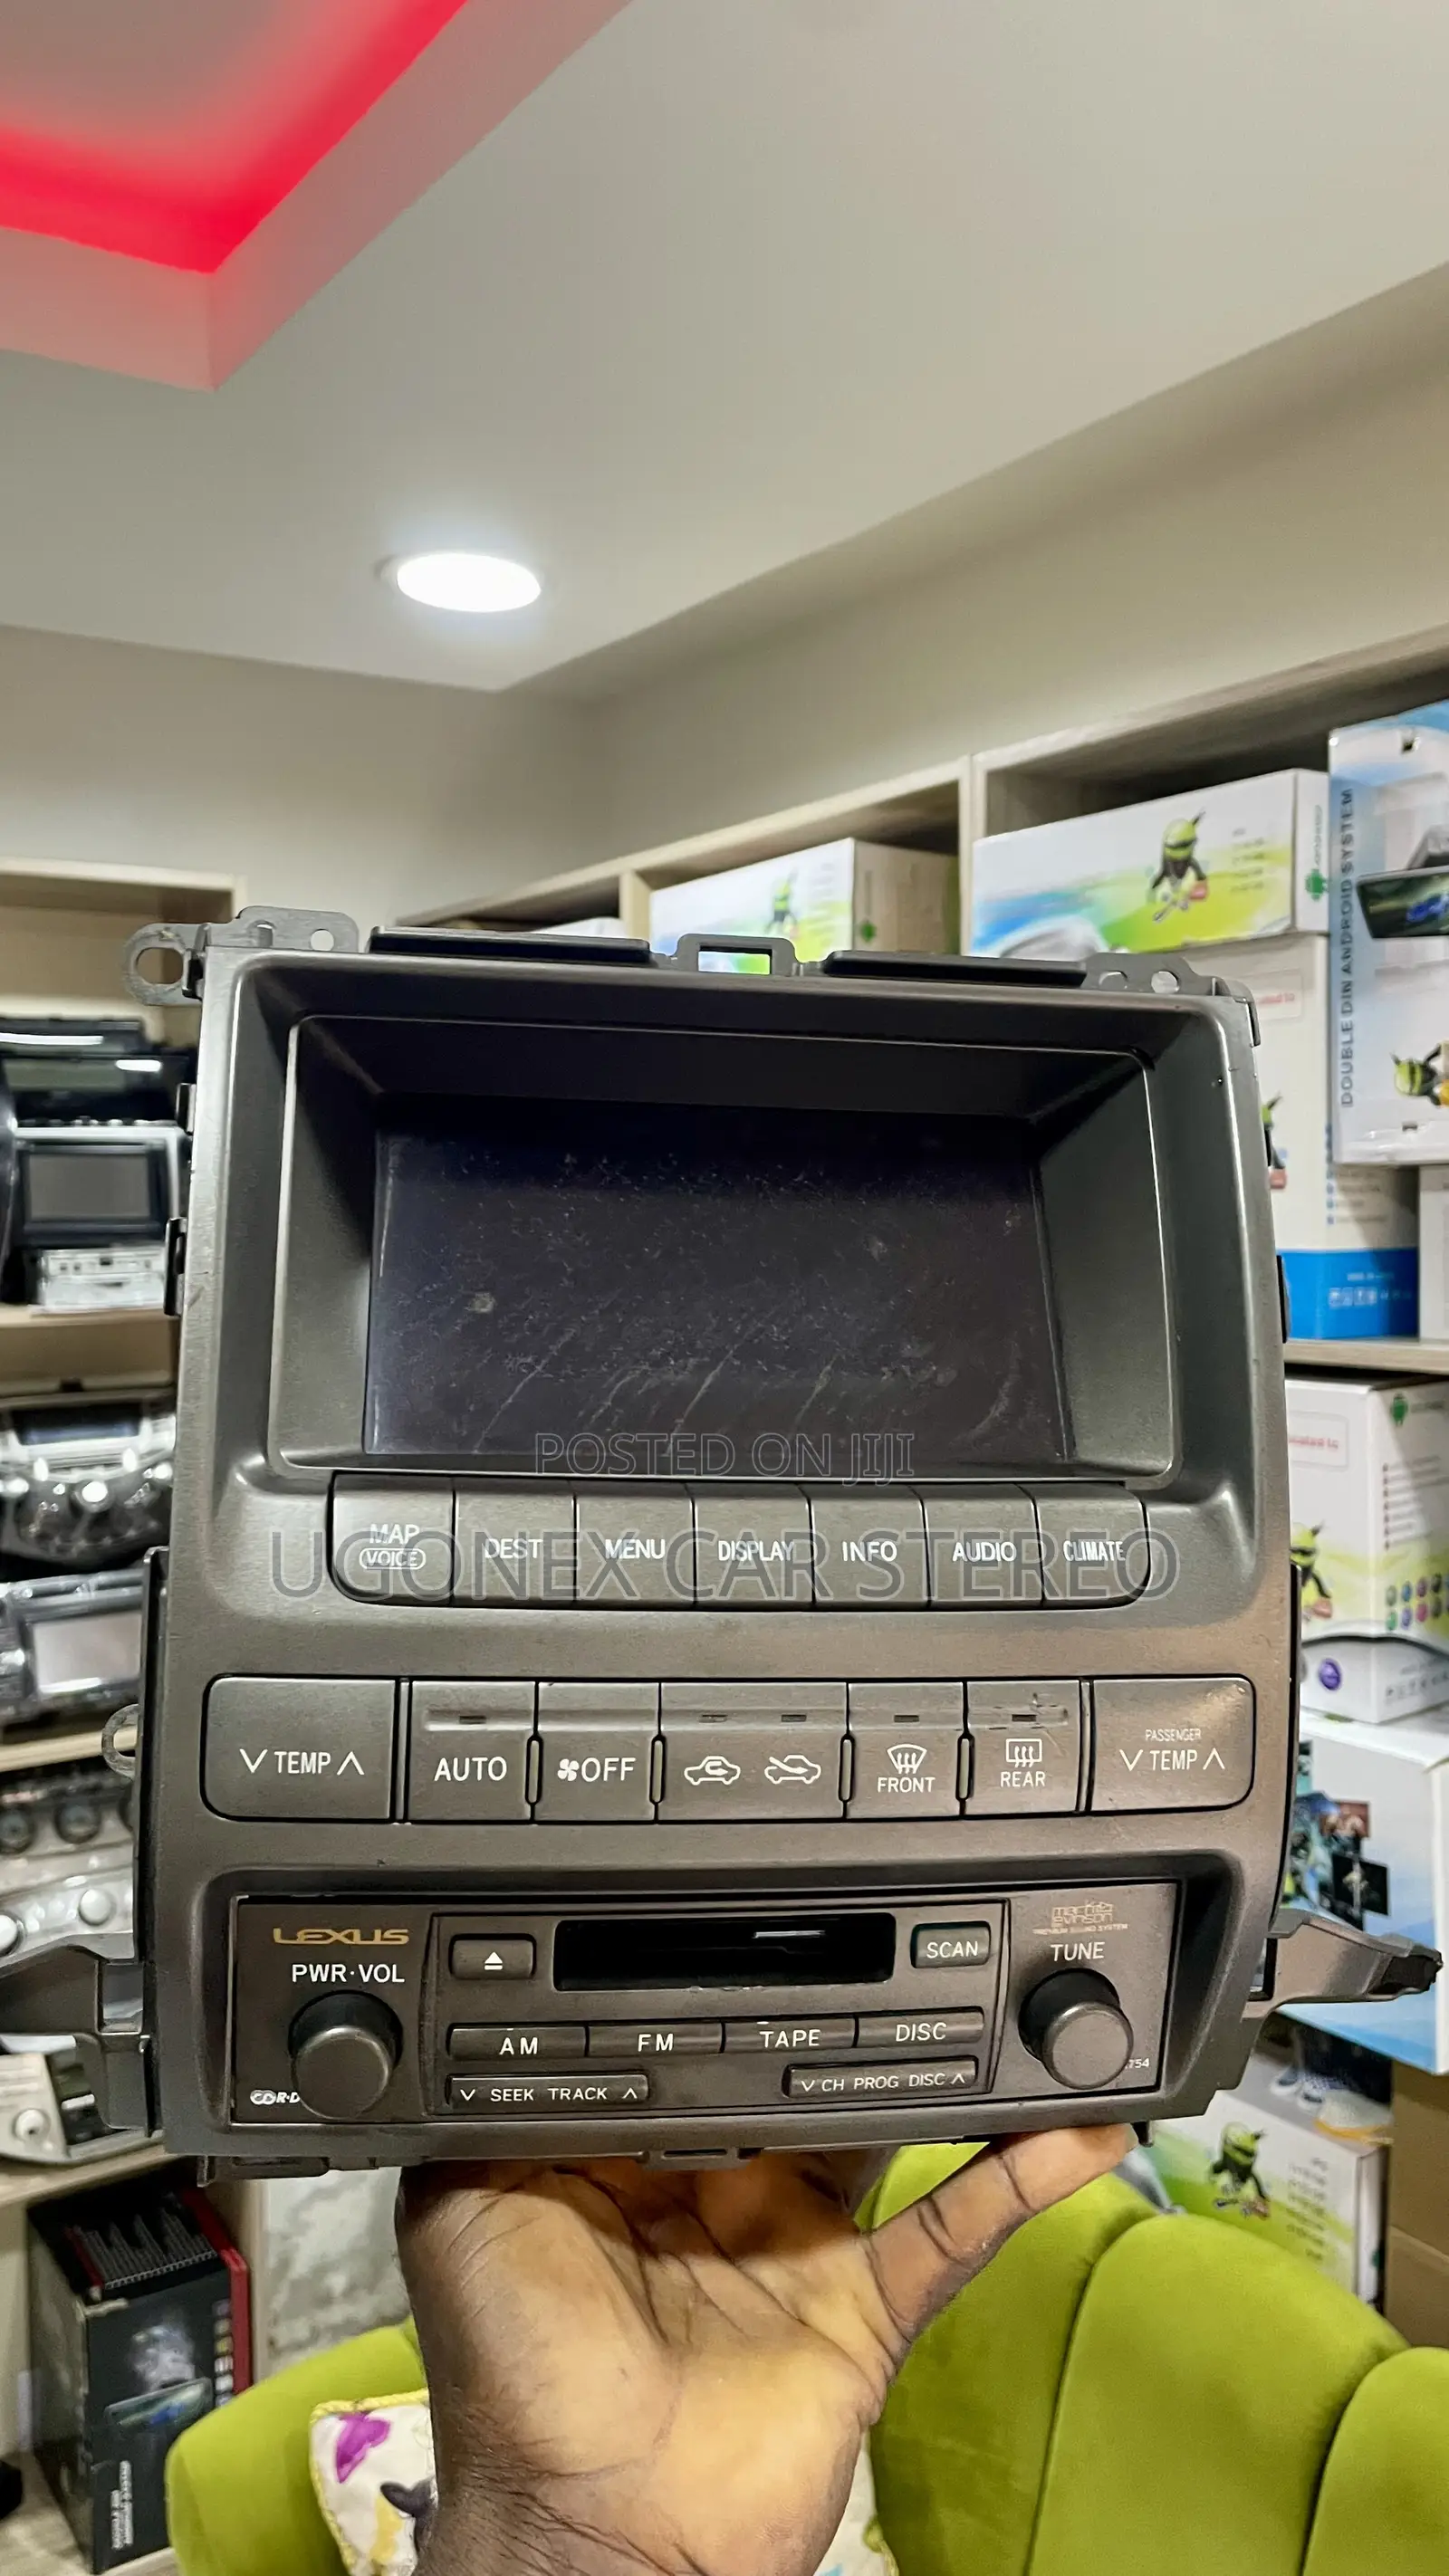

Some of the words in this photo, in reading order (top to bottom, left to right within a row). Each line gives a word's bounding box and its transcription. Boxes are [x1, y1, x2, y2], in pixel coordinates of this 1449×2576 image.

[1340, 787, 1354, 875] SYSTEM
[1340, 880, 1354, 975] ANDROID
[1341, 981, 1354, 1015] DIN
[1341, 1020, 1355, 1107] DOUBLE
[369, 1524, 419, 1545] MAP
[365, 1549, 418, 1567] VOICE
[485, 1538, 543, 1559] DEST
[605, 1538, 667, 1560] MENU
[717, 1540, 795, 1562] DISPLAY
[842, 1541, 897, 1562] INFO
[952, 1541, 1018, 1562] AUDIO
[1062, 1540, 1127, 1562] CLIMATE
[1145, 1728, 1203, 1742] PASSENGER
[273, 1750, 331, 1775] TEMP
[433, 1756, 508, 1782] AUTO
[581, 1757, 637, 1783] OFF
[1149, 1748, 1198, 1771] TEMP
[877, 1776, 936, 1794] FRONT
[1000, 1770, 1046, 1788] REAR
[273, 1928, 409, 1945] LEXUS
[926, 1940, 979, 1959] SCAN
[1051, 1941, 1106, 1962] TUNE
[637, 2033, 674, 2052] FM
[759, 2028, 821, 2048] TAPE
[895, 2022, 947, 2042] DISC
[499, 2036, 539, 2055] AM
[821, 2078, 845, 2092] CH
[853, 2074, 899, 2090] PROG
[908, 2073, 946, 2087] DISC
[490, 2088, 534, 2102] SEEK
[547, 2086, 609, 2101] TRACK
